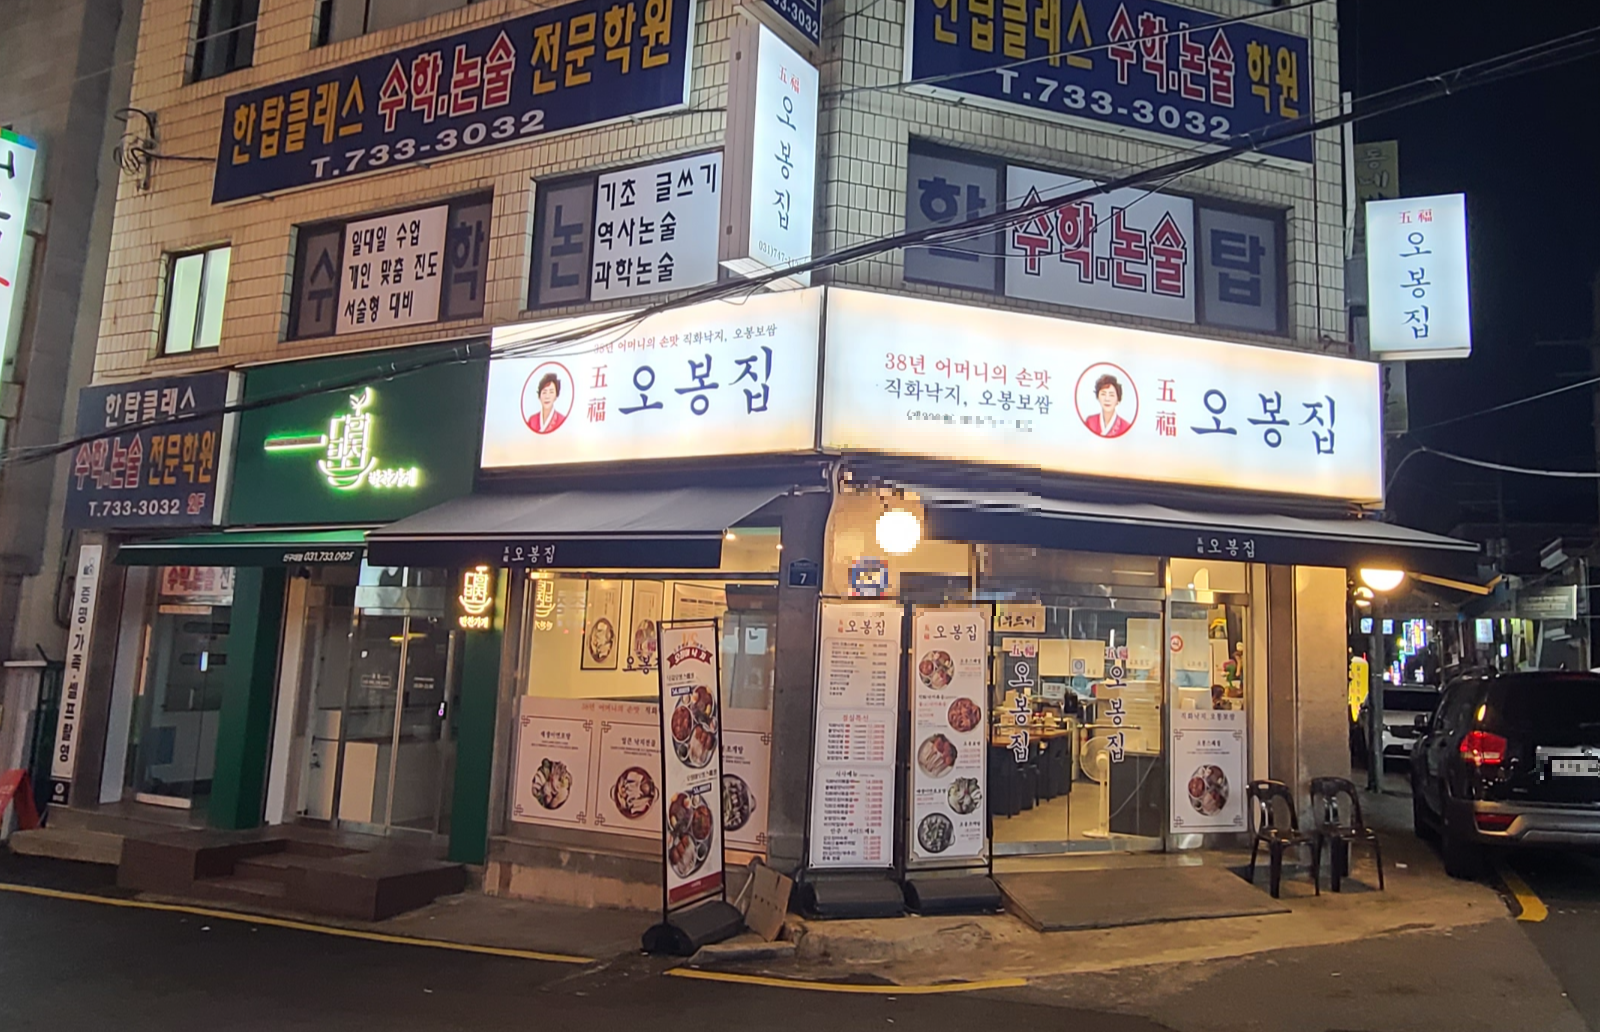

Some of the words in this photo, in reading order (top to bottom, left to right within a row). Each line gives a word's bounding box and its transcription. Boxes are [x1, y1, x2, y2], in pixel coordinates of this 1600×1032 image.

[231, 75, 364, 166] 한탑클래스
[529, 0, 672, 96] 전문학원
[1246, 39, 1300, 119] 학원
[995, 68, 1232, 140] T.733-3032
[310, 109, 546, 179] T.733-3032
[771, 95, 798, 232] 오봉집
[600, 178, 636, 210] 기초
[655, 163, 717, 204] 글쓰기
[597, 211, 677, 251] 역사논술
[1398, 208, 1433, 224] 五福
[351, 226, 388, 257] 일대일
[396, 219, 422, 249] 수업
[348, 262, 371, 290] 개인
[380, 257, 404, 286] 맞춤
[414, 251, 438, 281] 진도
[594, 252, 675, 290] 과학논술
[1210, 226, 1266, 306] 탑
[1398, 231, 1433, 340] 오봉집
[344, 295, 379, 325] 서술형
[389, 290, 414, 319] 대비
[617, 334, 655, 352] 어머니의
[659, 332, 680, 348] 손맛
[682, 328, 728, 346] 직화낙지,
[732, 324, 778, 340] 오봉보쌈
[618, 346, 773, 416] 오봉집
[884, 352, 927, 376] 38년
[934, 358, 1008, 385] 어머니의
[1015, 366, 1052, 390] 손맛
[105, 385, 196, 428] 한탑클래스
[586, 364, 608, 423] 五福
[883, 378, 968, 408] 직화낙지,
[977, 389, 1053, 416] 오봉보쌈
[1155, 378, 1178, 438] 五福
[1190, 388, 1336, 456] 오봉집
[148, 430, 216, 485] 전문학원
[88, 499, 180, 517] T.733-3032
[511, 545, 555, 563] 오봉집
[1207, 538, 1255, 558] 오봉집
[800, 572, 807, 585] 7
[459, 616, 488, 629] 반찬가게
[845, 619, 885, 636] 오봉집
[933, 624, 977, 641] 오봉집
[622, 656, 658, 674] 오봉
[1008, 661, 1034, 762] 오봉집
[1105, 665, 1127, 763] 오봉집
